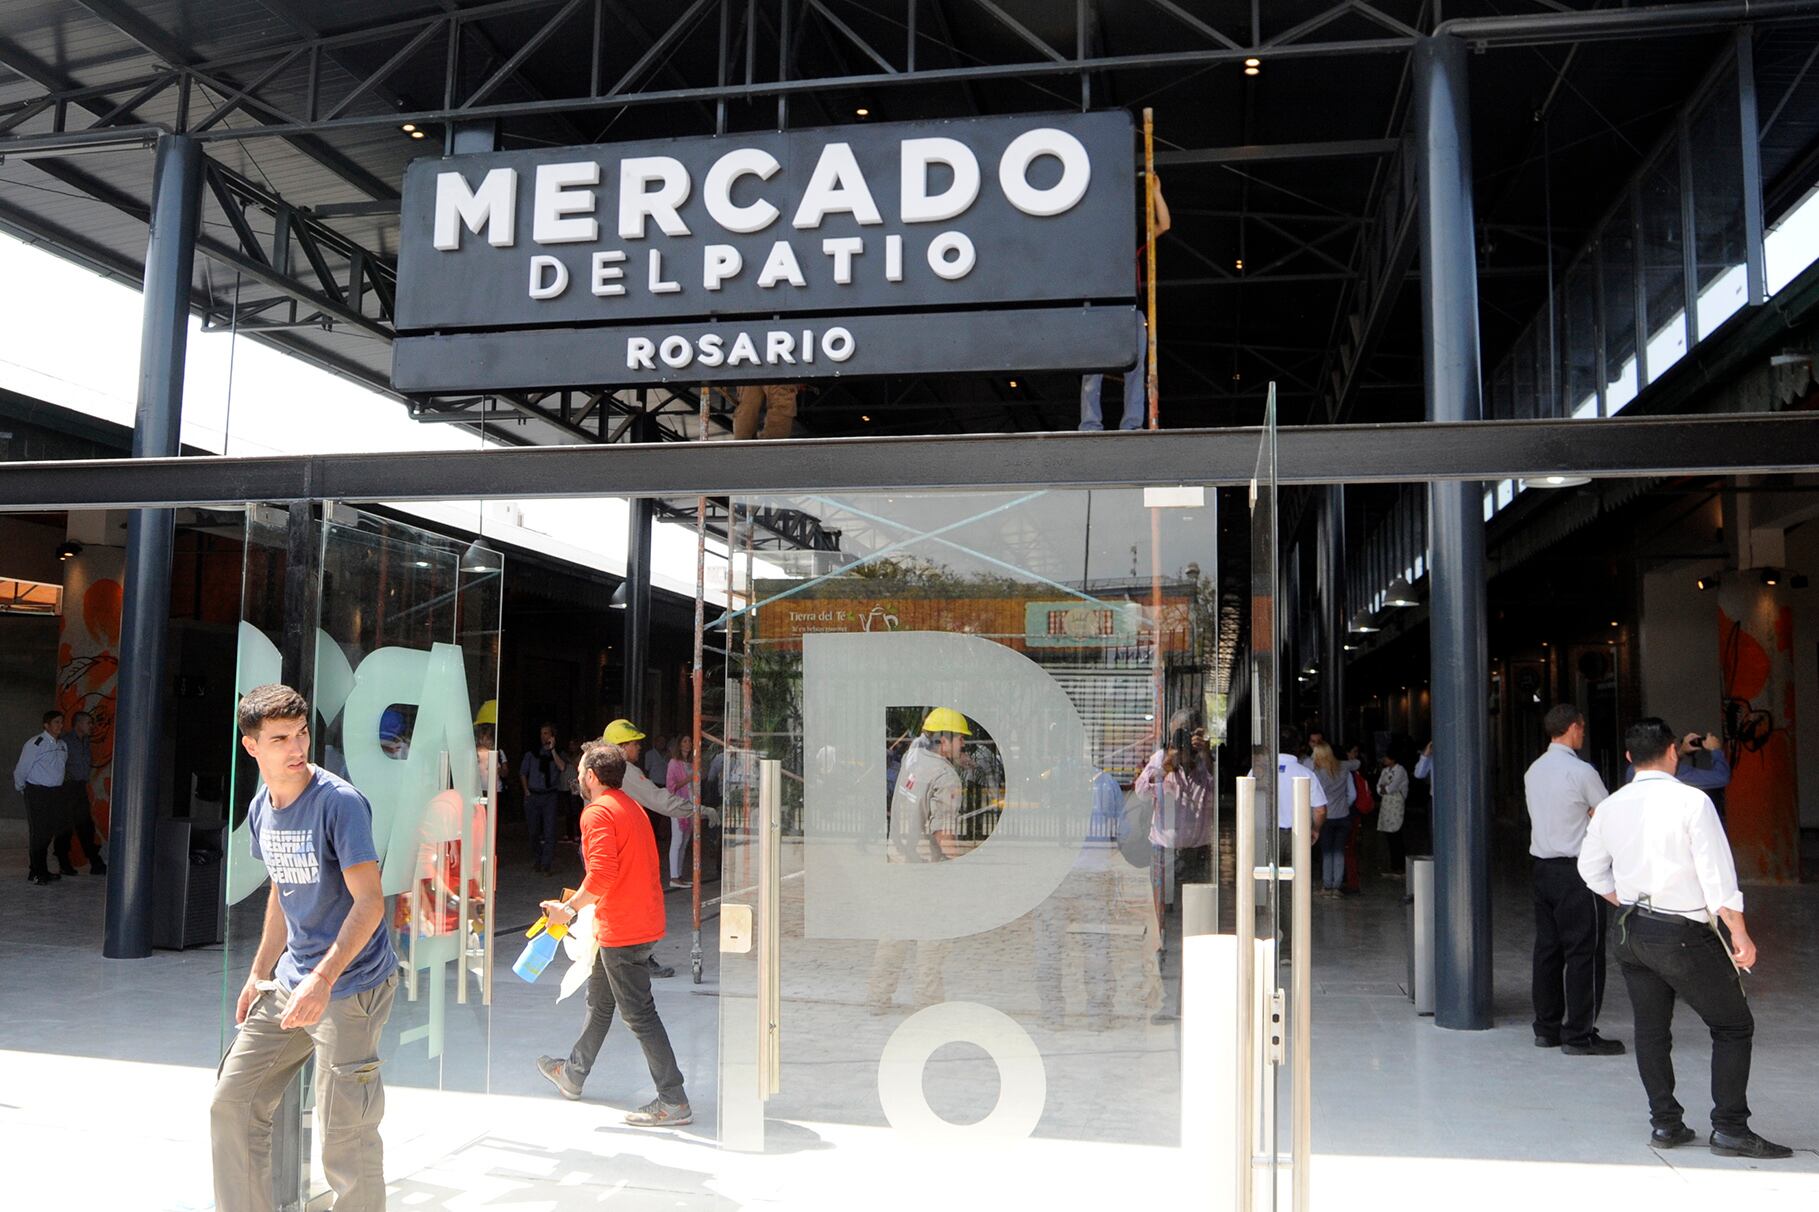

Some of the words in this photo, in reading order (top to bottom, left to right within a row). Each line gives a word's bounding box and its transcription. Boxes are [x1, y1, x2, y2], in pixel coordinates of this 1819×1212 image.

[433, 128, 1092, 251] MERCADO
[529, 248, 681, 299] DEL
[703, 231, 977, 291] PATIO
[626, 326, 857, 370] ROSARIO
[264, 852, 320, 867] GENTINA
[267, 866, 321, 884] GENTINA
